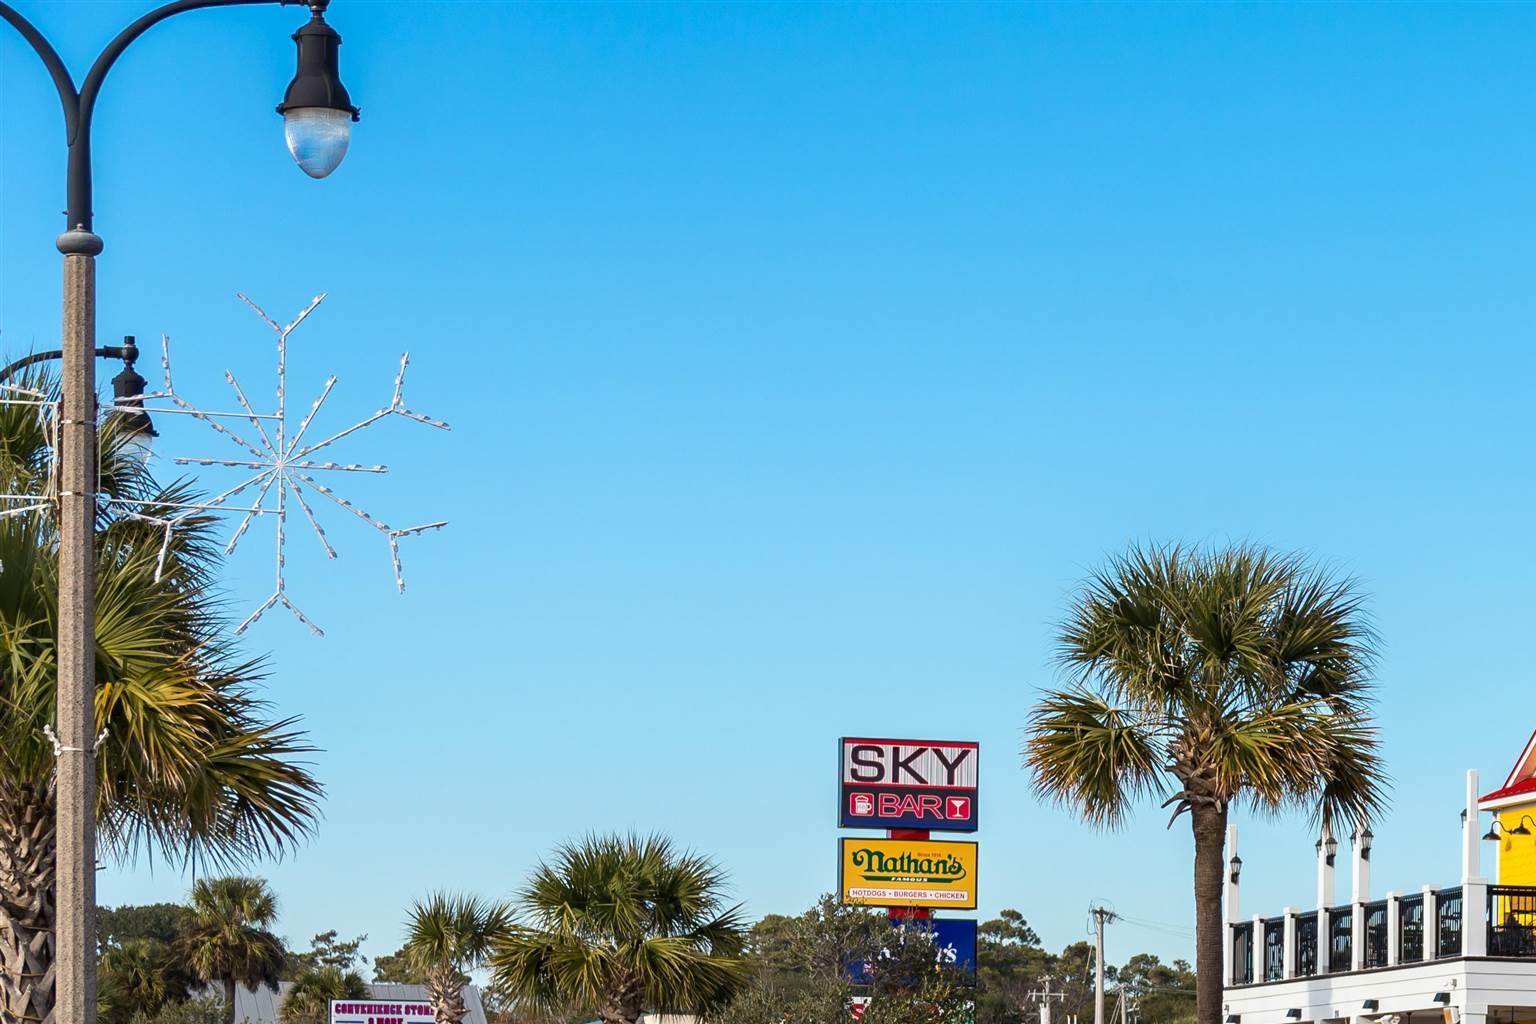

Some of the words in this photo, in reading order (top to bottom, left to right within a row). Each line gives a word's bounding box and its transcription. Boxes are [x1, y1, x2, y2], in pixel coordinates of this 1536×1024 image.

[850, 745, 971, 785] SKY
[878, 793, 944, 819] BAR
[852, 848, 965, 876] Nathan's
[335, 1003, 402, 1015] CONVENIENCE
